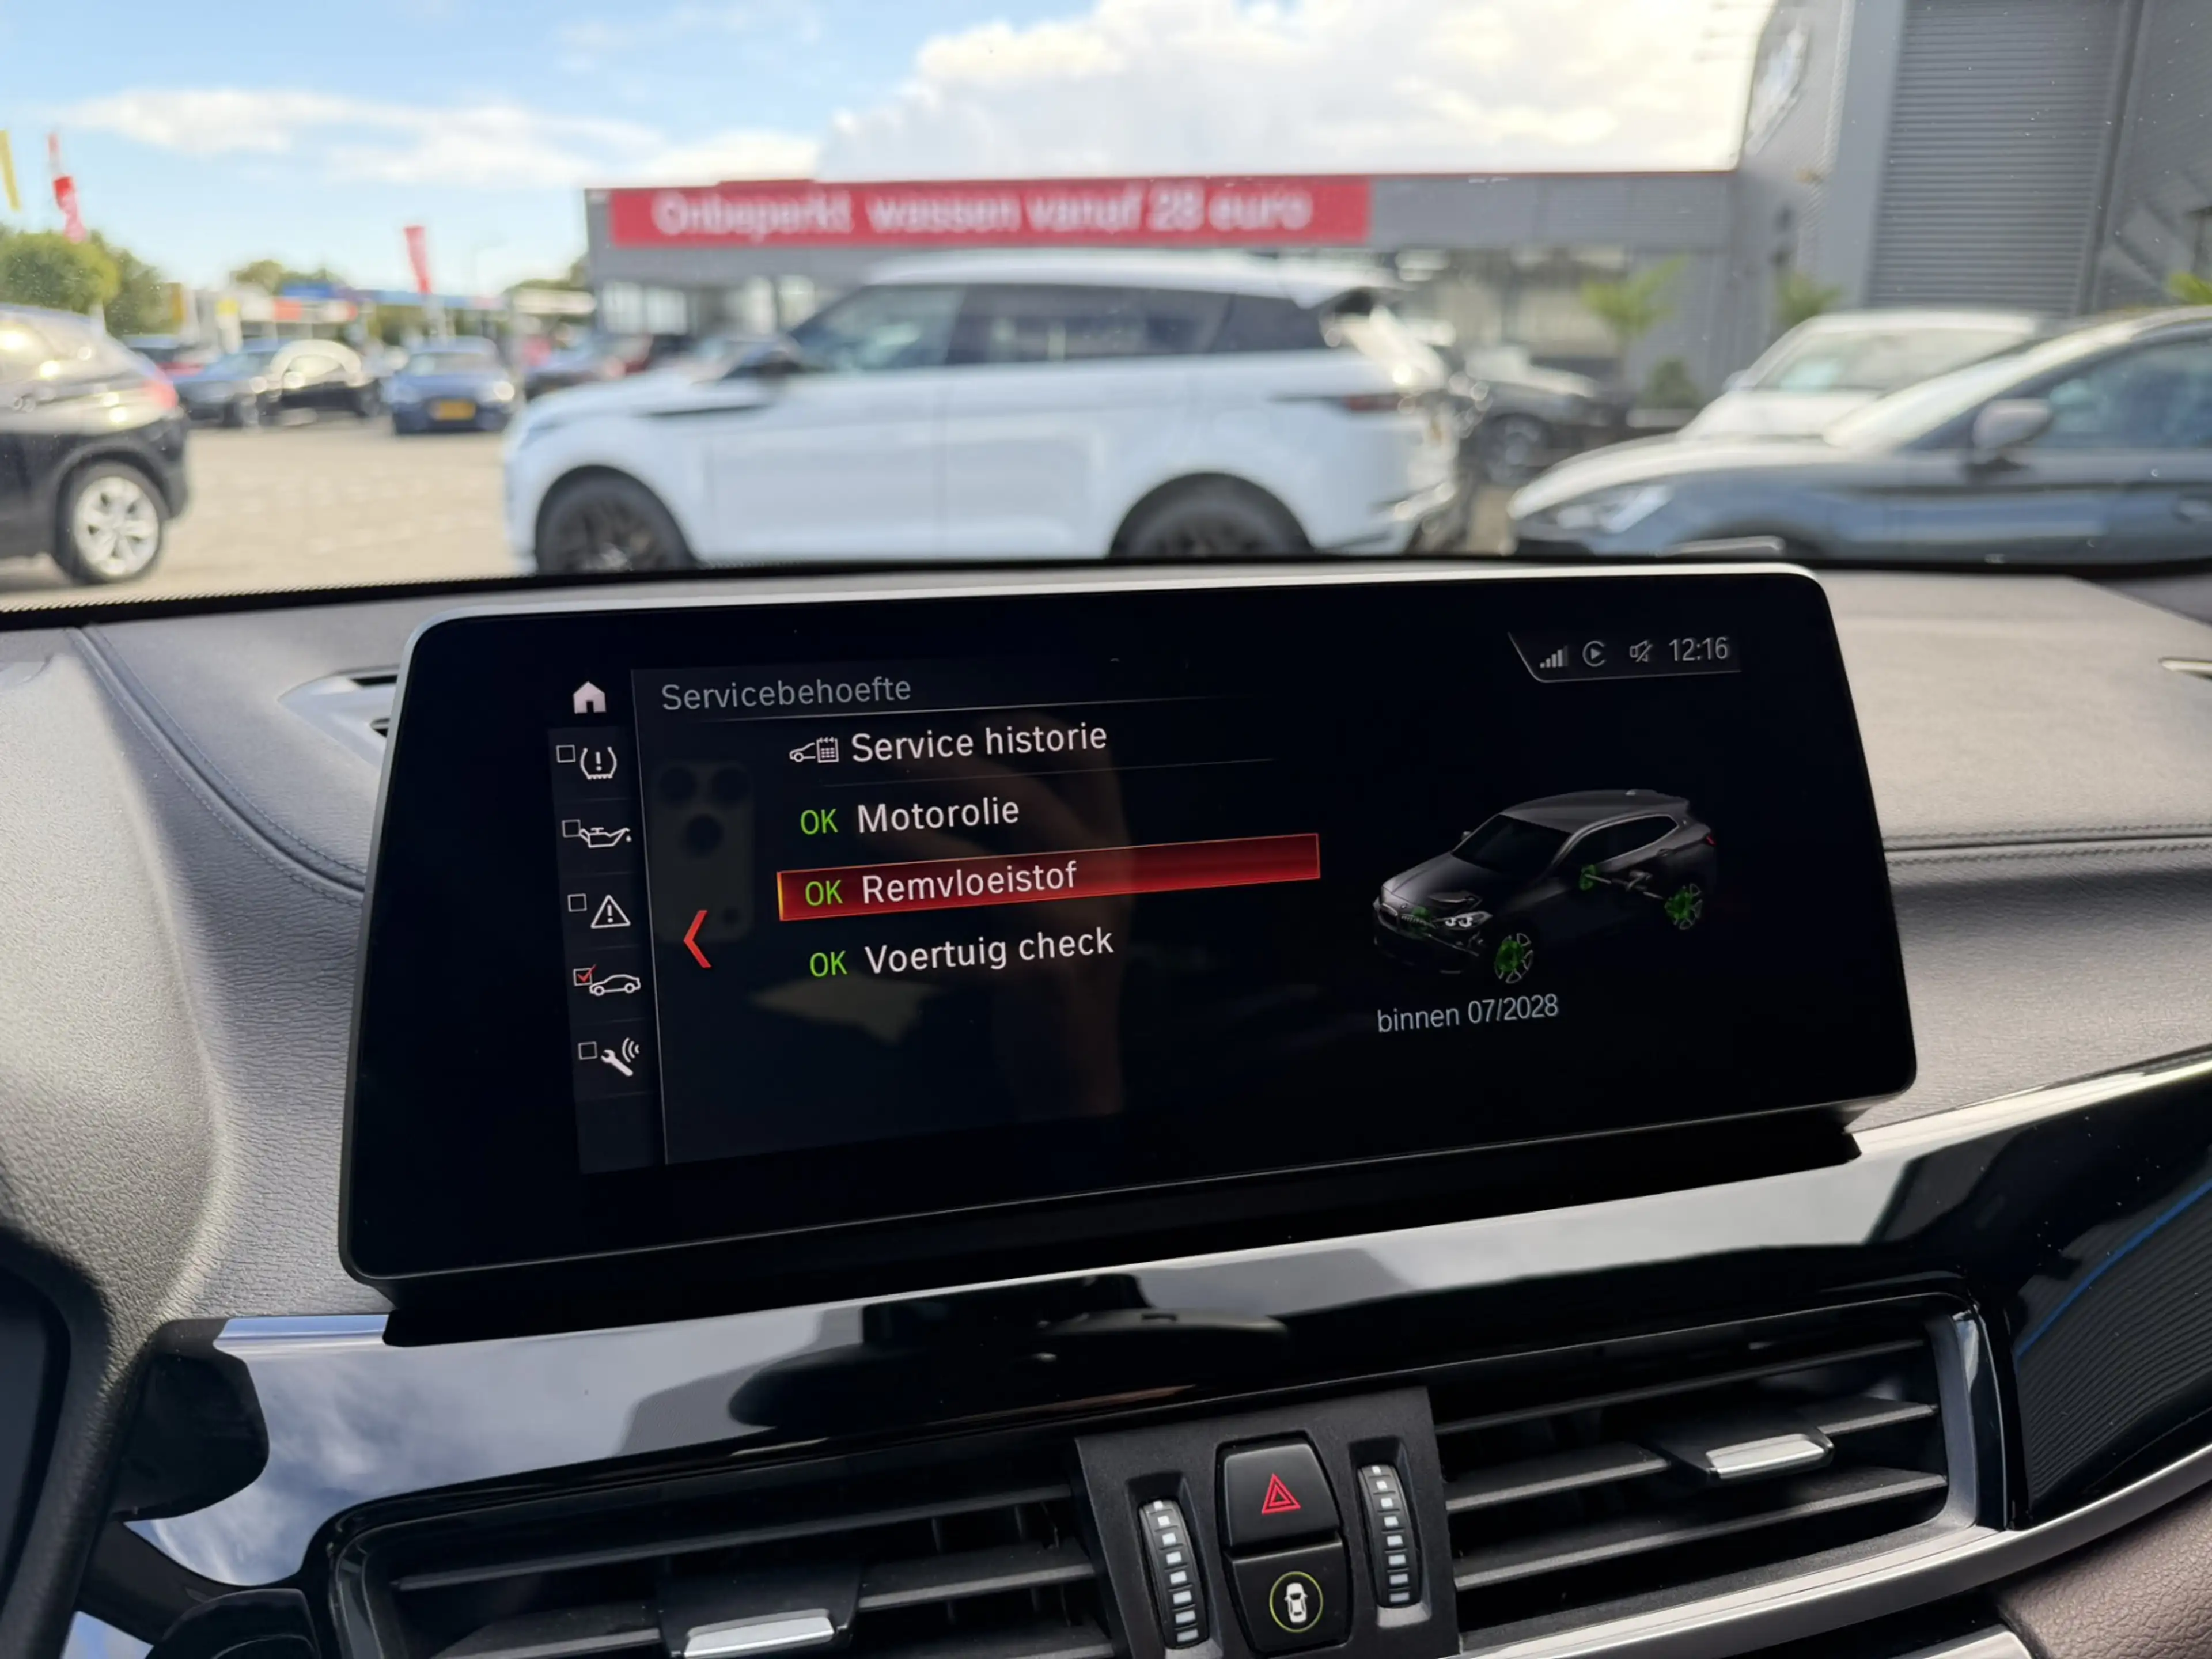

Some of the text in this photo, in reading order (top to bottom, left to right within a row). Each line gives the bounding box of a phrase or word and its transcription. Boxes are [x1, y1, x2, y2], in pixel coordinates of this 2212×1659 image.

[1209, 189, 1314, 231] euro
[1669, 637, 1729, 662] 12:16
[661, 676, 912, 710] Servicebehoefte
[851, 722, 1107, 762] Service historie
[800, 797, 1020, 835] OK Motorolie
[805, 860, 1078, 906] OK Remvloeistof
[810, 927, 1114, 977] OK Voertuig check
[1377, 993, 1559, 1033] binnen 07/2028
